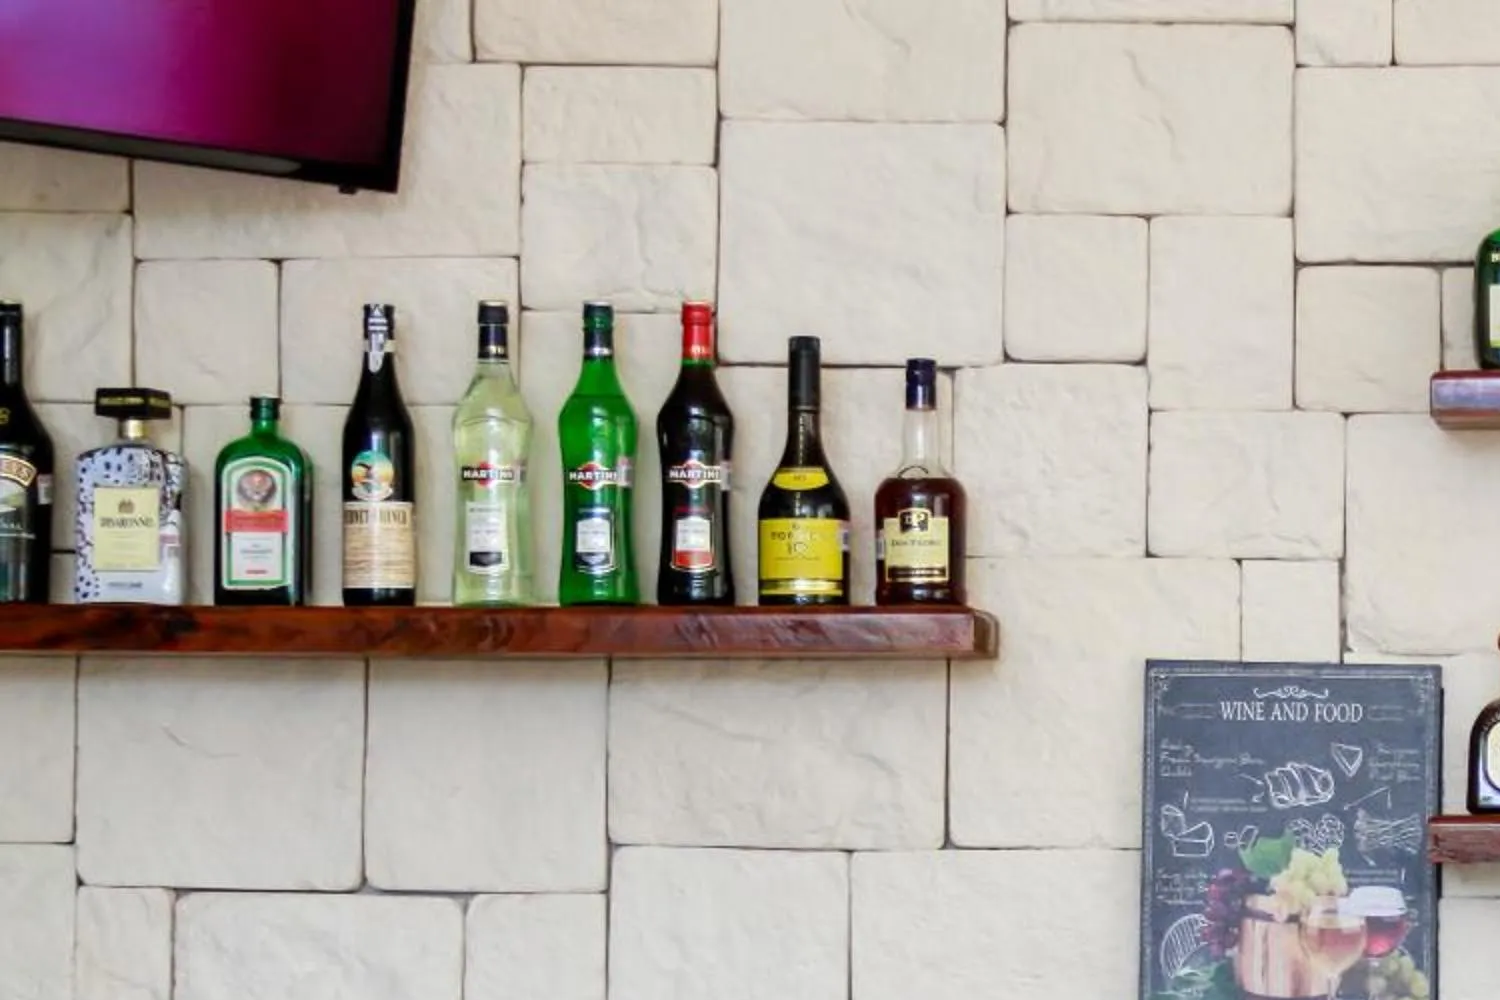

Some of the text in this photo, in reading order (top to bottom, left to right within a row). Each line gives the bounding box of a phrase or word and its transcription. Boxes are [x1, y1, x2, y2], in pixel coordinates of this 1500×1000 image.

[462, 469, 515, 480] MARTINI
[568, 470, 618, 482] MARTINI
[669, 469, 720, 480] MARTINI
[1220, 701, 1364, 723] WINE AND FOOD
